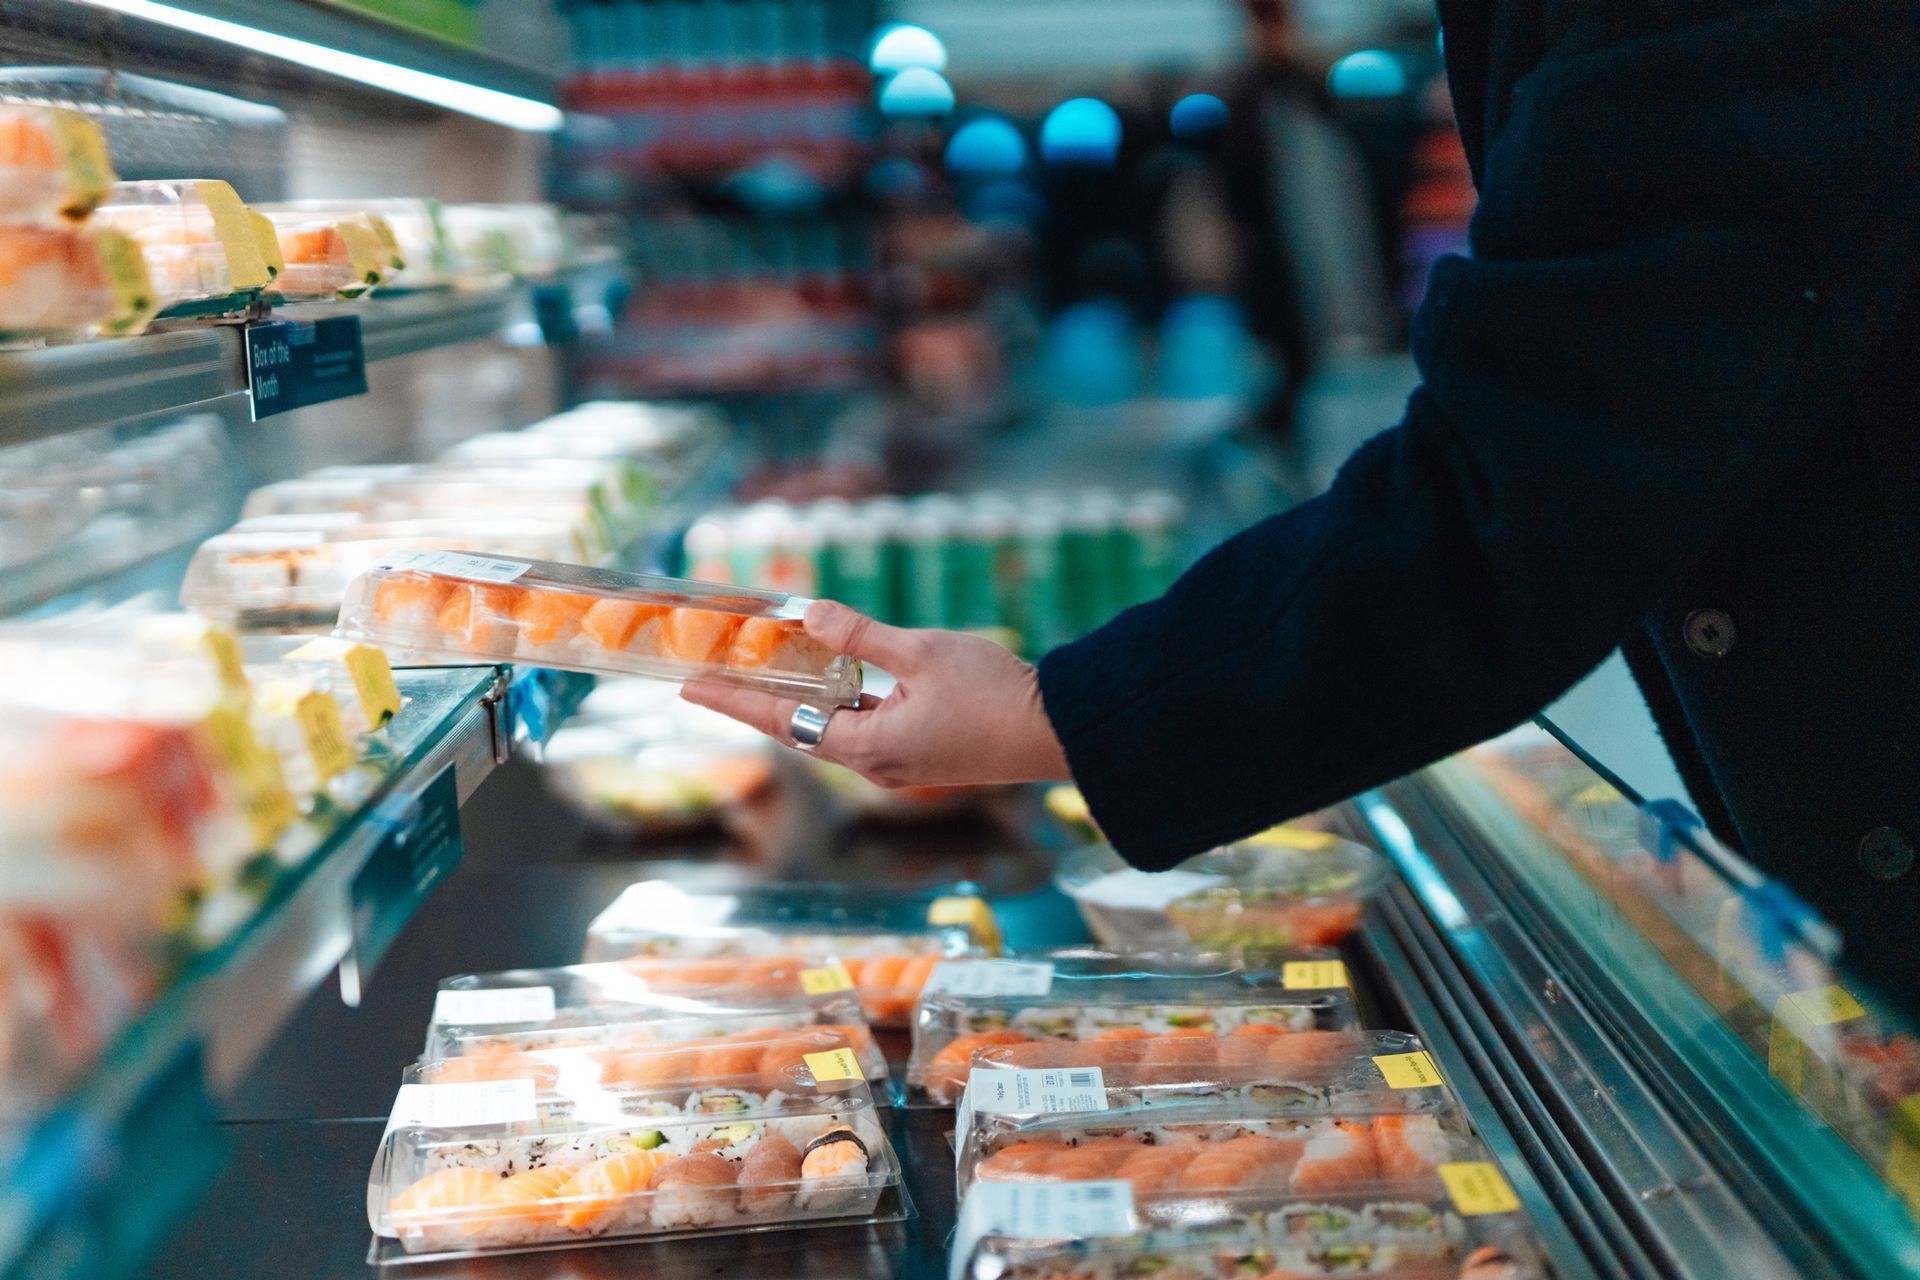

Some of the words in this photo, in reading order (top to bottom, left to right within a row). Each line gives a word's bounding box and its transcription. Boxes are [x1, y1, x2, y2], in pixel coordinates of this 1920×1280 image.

[254, 344, 269, 368] Box
[269, 341, 277, 365] of
[277, 341, 290, 363] the
[256, 373, 279, 400] Month
